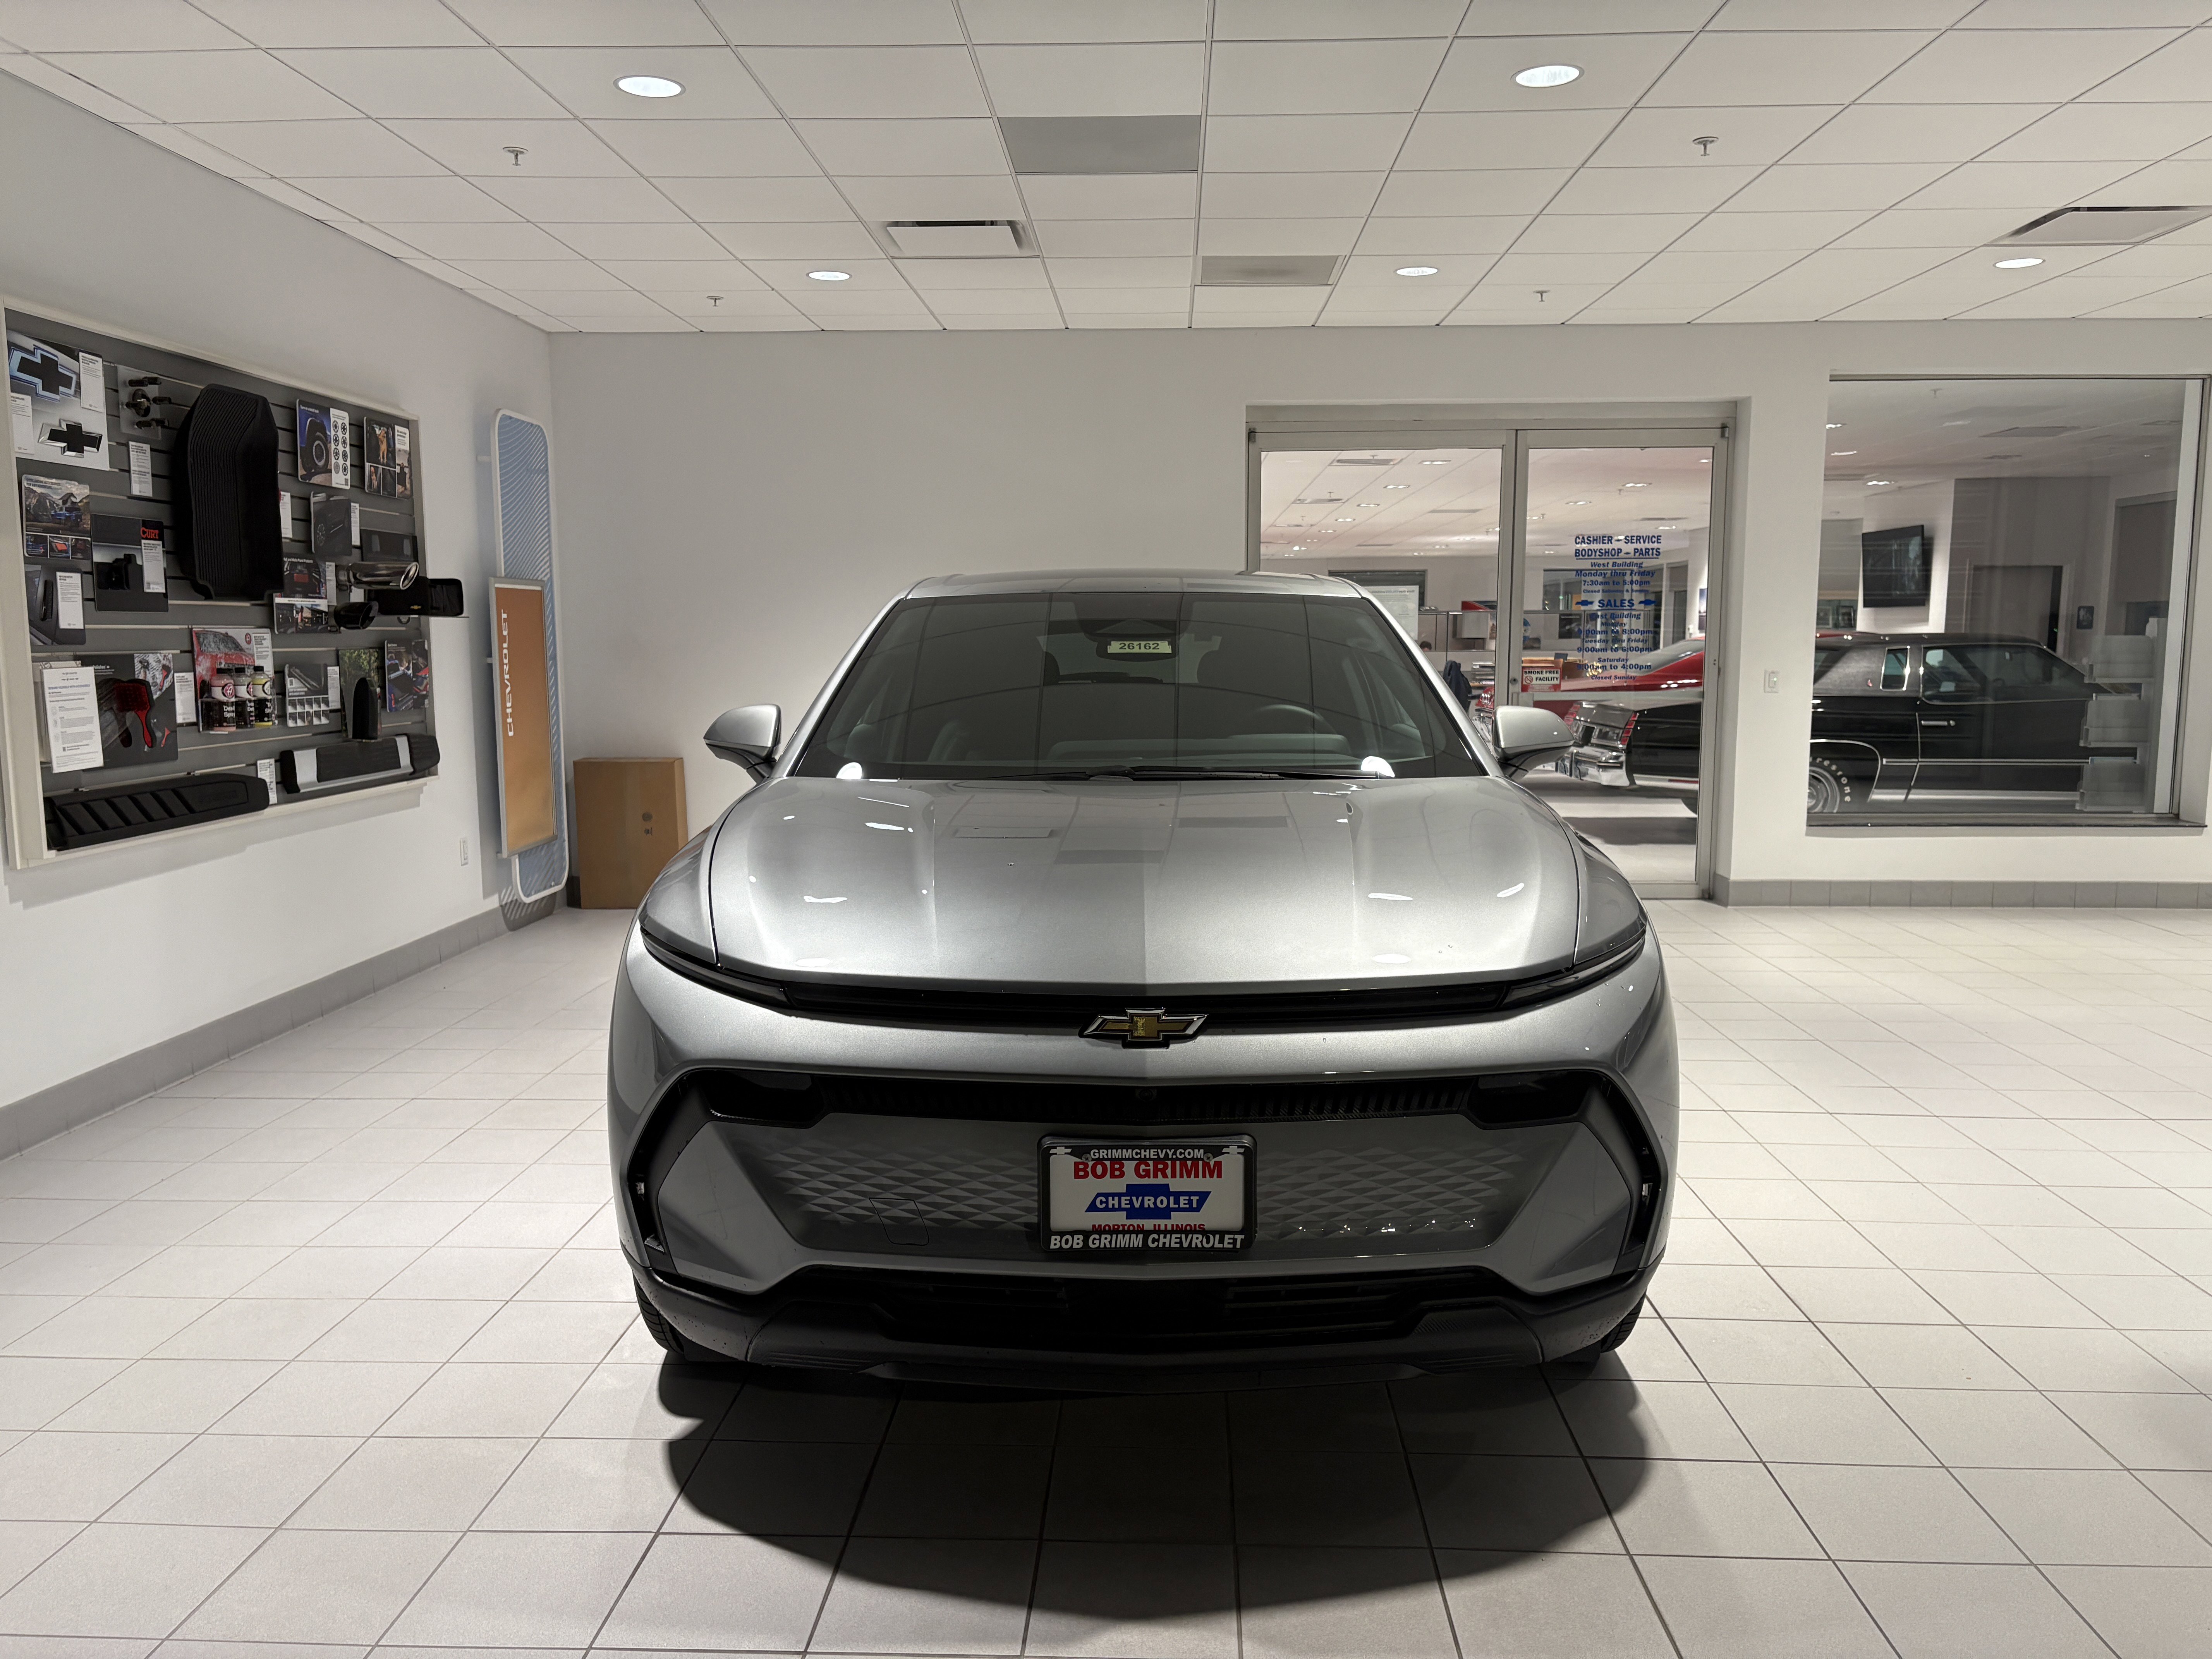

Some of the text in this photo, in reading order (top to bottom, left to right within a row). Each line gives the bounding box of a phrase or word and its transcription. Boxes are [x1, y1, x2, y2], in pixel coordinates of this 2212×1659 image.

[140, 527, 159, 539] CURT
[1575, 535, 1662, 545] CASHIER SERVICE
[1575, 548, 1661, 557] BODYSHOP PARTS
[1612, 561, 1644, 569] Building
[1575, 570, 1608, 578] Monday
[1598, 599, 1635, 608] SALES
[1119, 642, 1160, 650] 26162
[501, 609, 514, 737] CHEVROLET
[1809, 756, 1851, 802] irestone
[1090, 1149, 1204, 1159] GRIMMCHEVY.COM
[1074, 1160, 1223, 1179] BOB GRIMM
[1095, 1196, 1200, 1208] CHEVROLET
[1050, 1234, 1245, 1249] BOB GRIMM CHEVROLET
